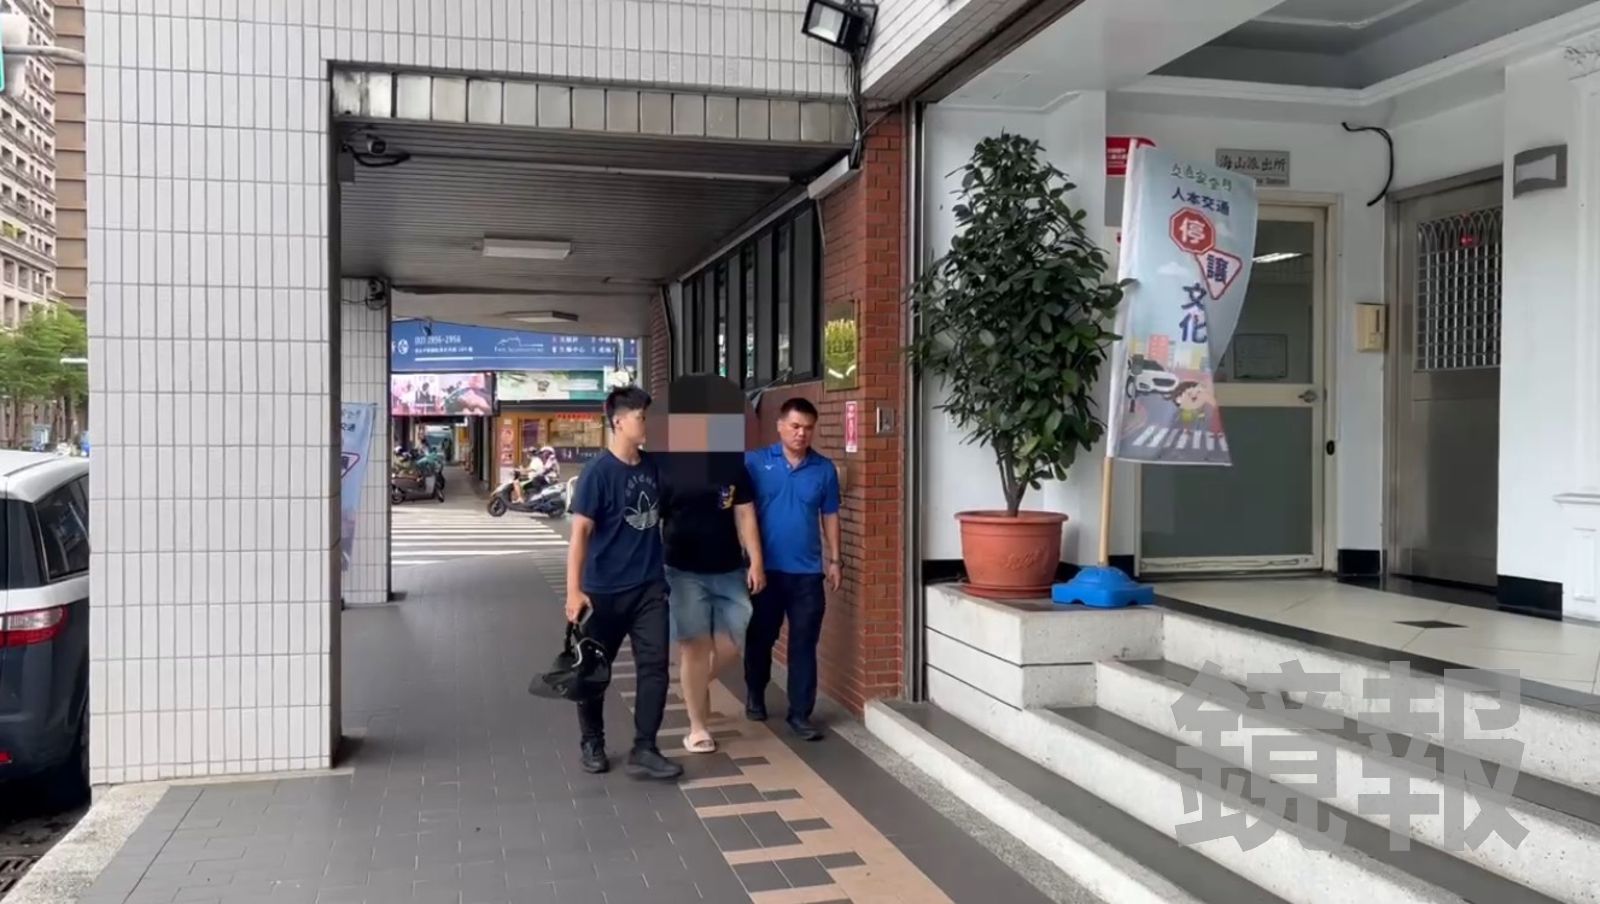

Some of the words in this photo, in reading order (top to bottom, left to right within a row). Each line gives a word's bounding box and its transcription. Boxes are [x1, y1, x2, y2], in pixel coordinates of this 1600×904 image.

[1219, 155, 1287, 172] 海山派出所
[1171, 186, 1230, 217] 人本交通
[1178, 216, 1206, 245] 停
[1206, 254, 1229, 287] 讓
[1178, 282, 1208, 343] 文化
